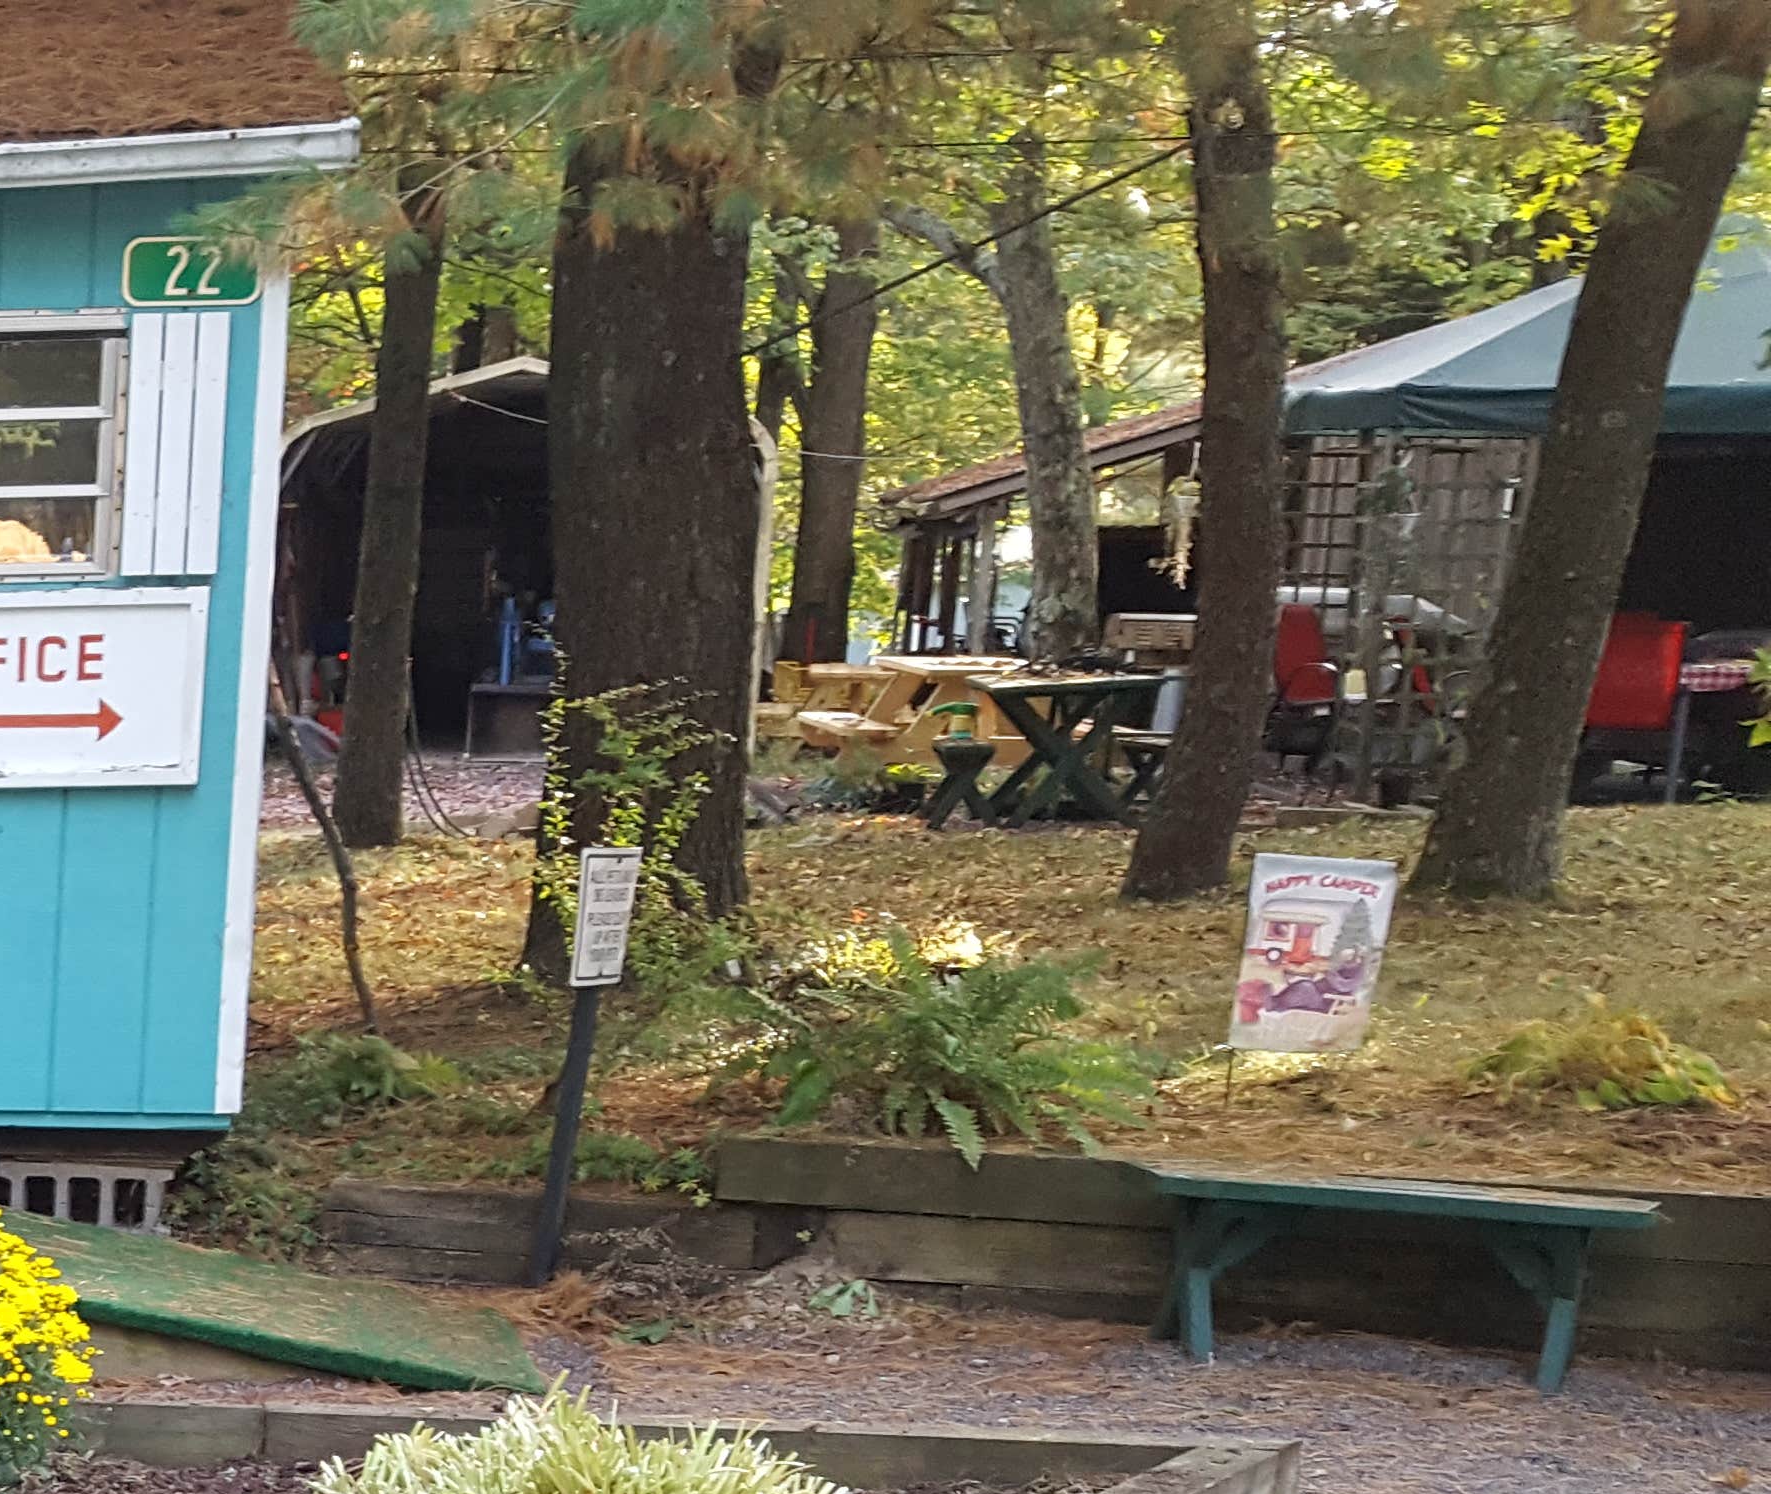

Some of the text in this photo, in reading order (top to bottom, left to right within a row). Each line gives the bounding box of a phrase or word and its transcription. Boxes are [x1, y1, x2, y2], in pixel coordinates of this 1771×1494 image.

[164, 245, 222, 296] 22
[1266, 874, 1380, 898] HAPPY CAMPER
